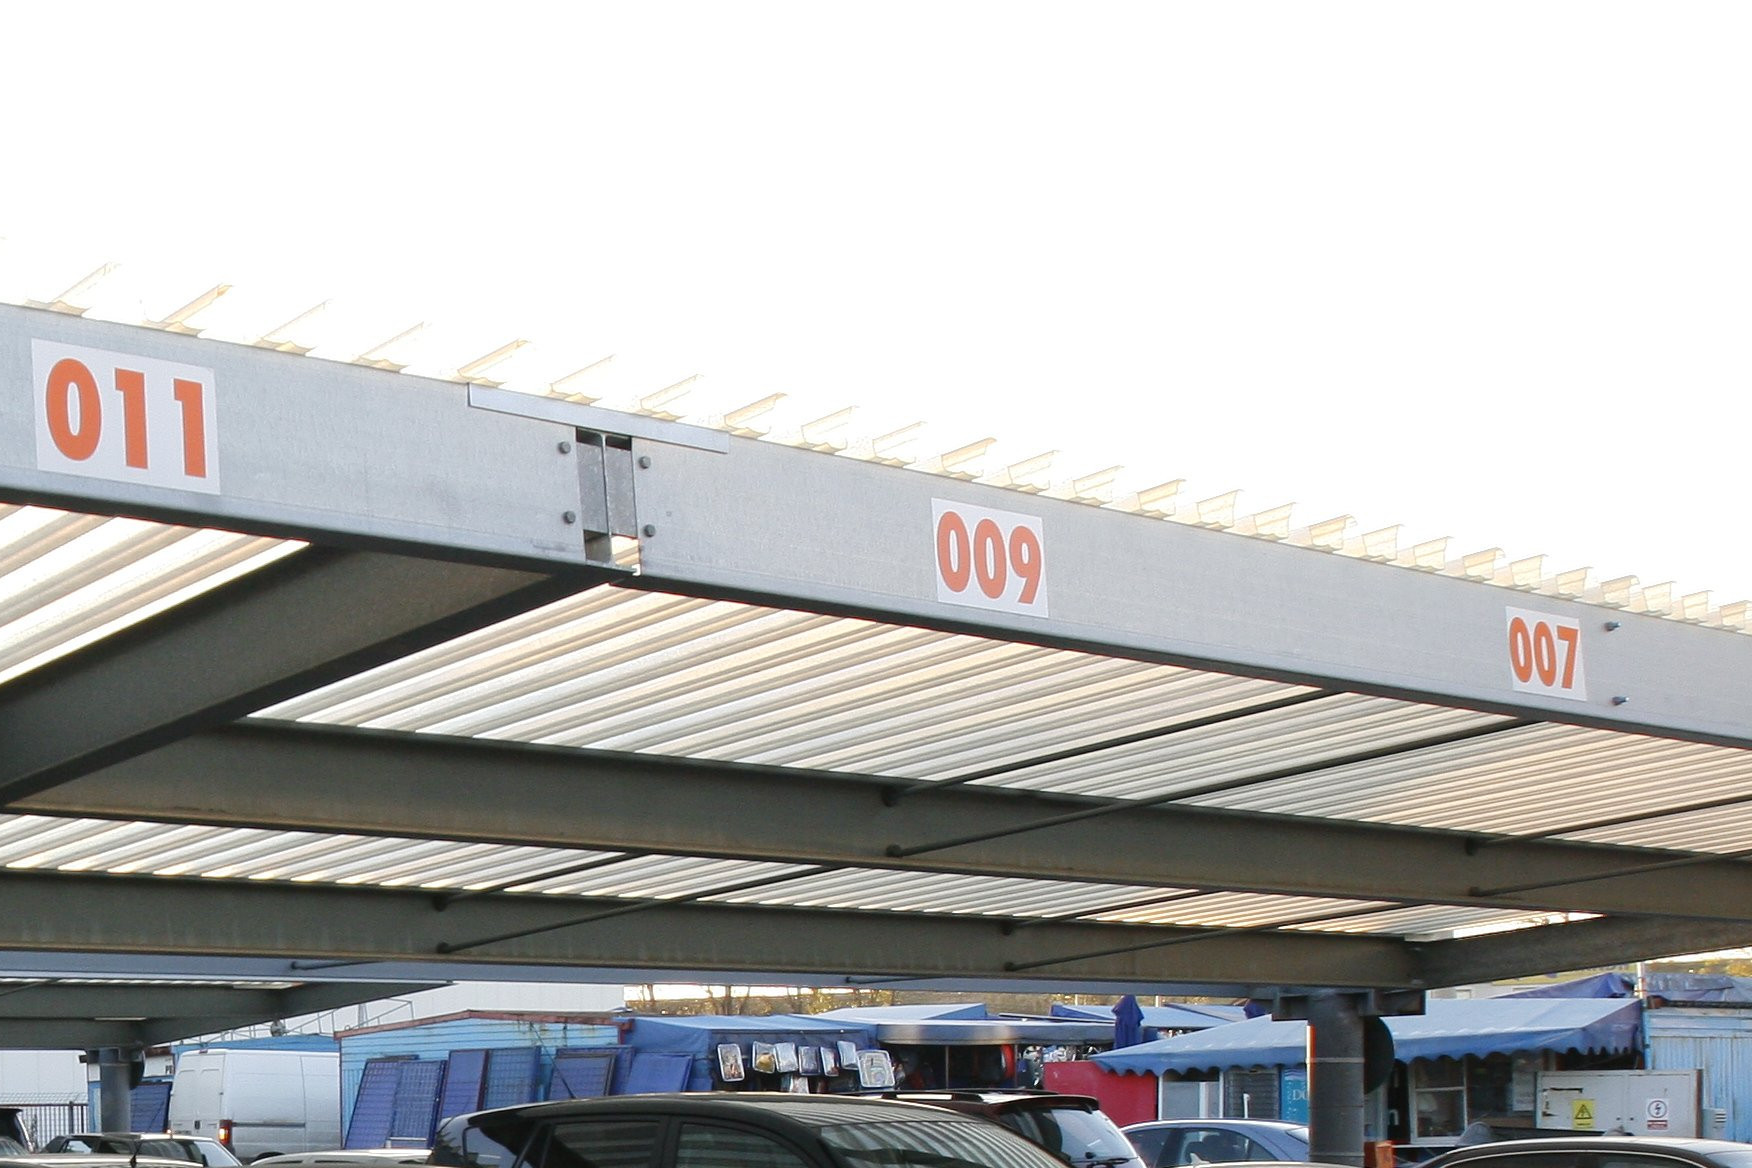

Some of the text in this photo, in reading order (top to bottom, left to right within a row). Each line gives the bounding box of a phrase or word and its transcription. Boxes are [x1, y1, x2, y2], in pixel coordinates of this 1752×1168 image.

[45, 357, 207, 479] 011
[936, 510, 1042, 605] 009
[1509, 616, 1579, 690] 007
